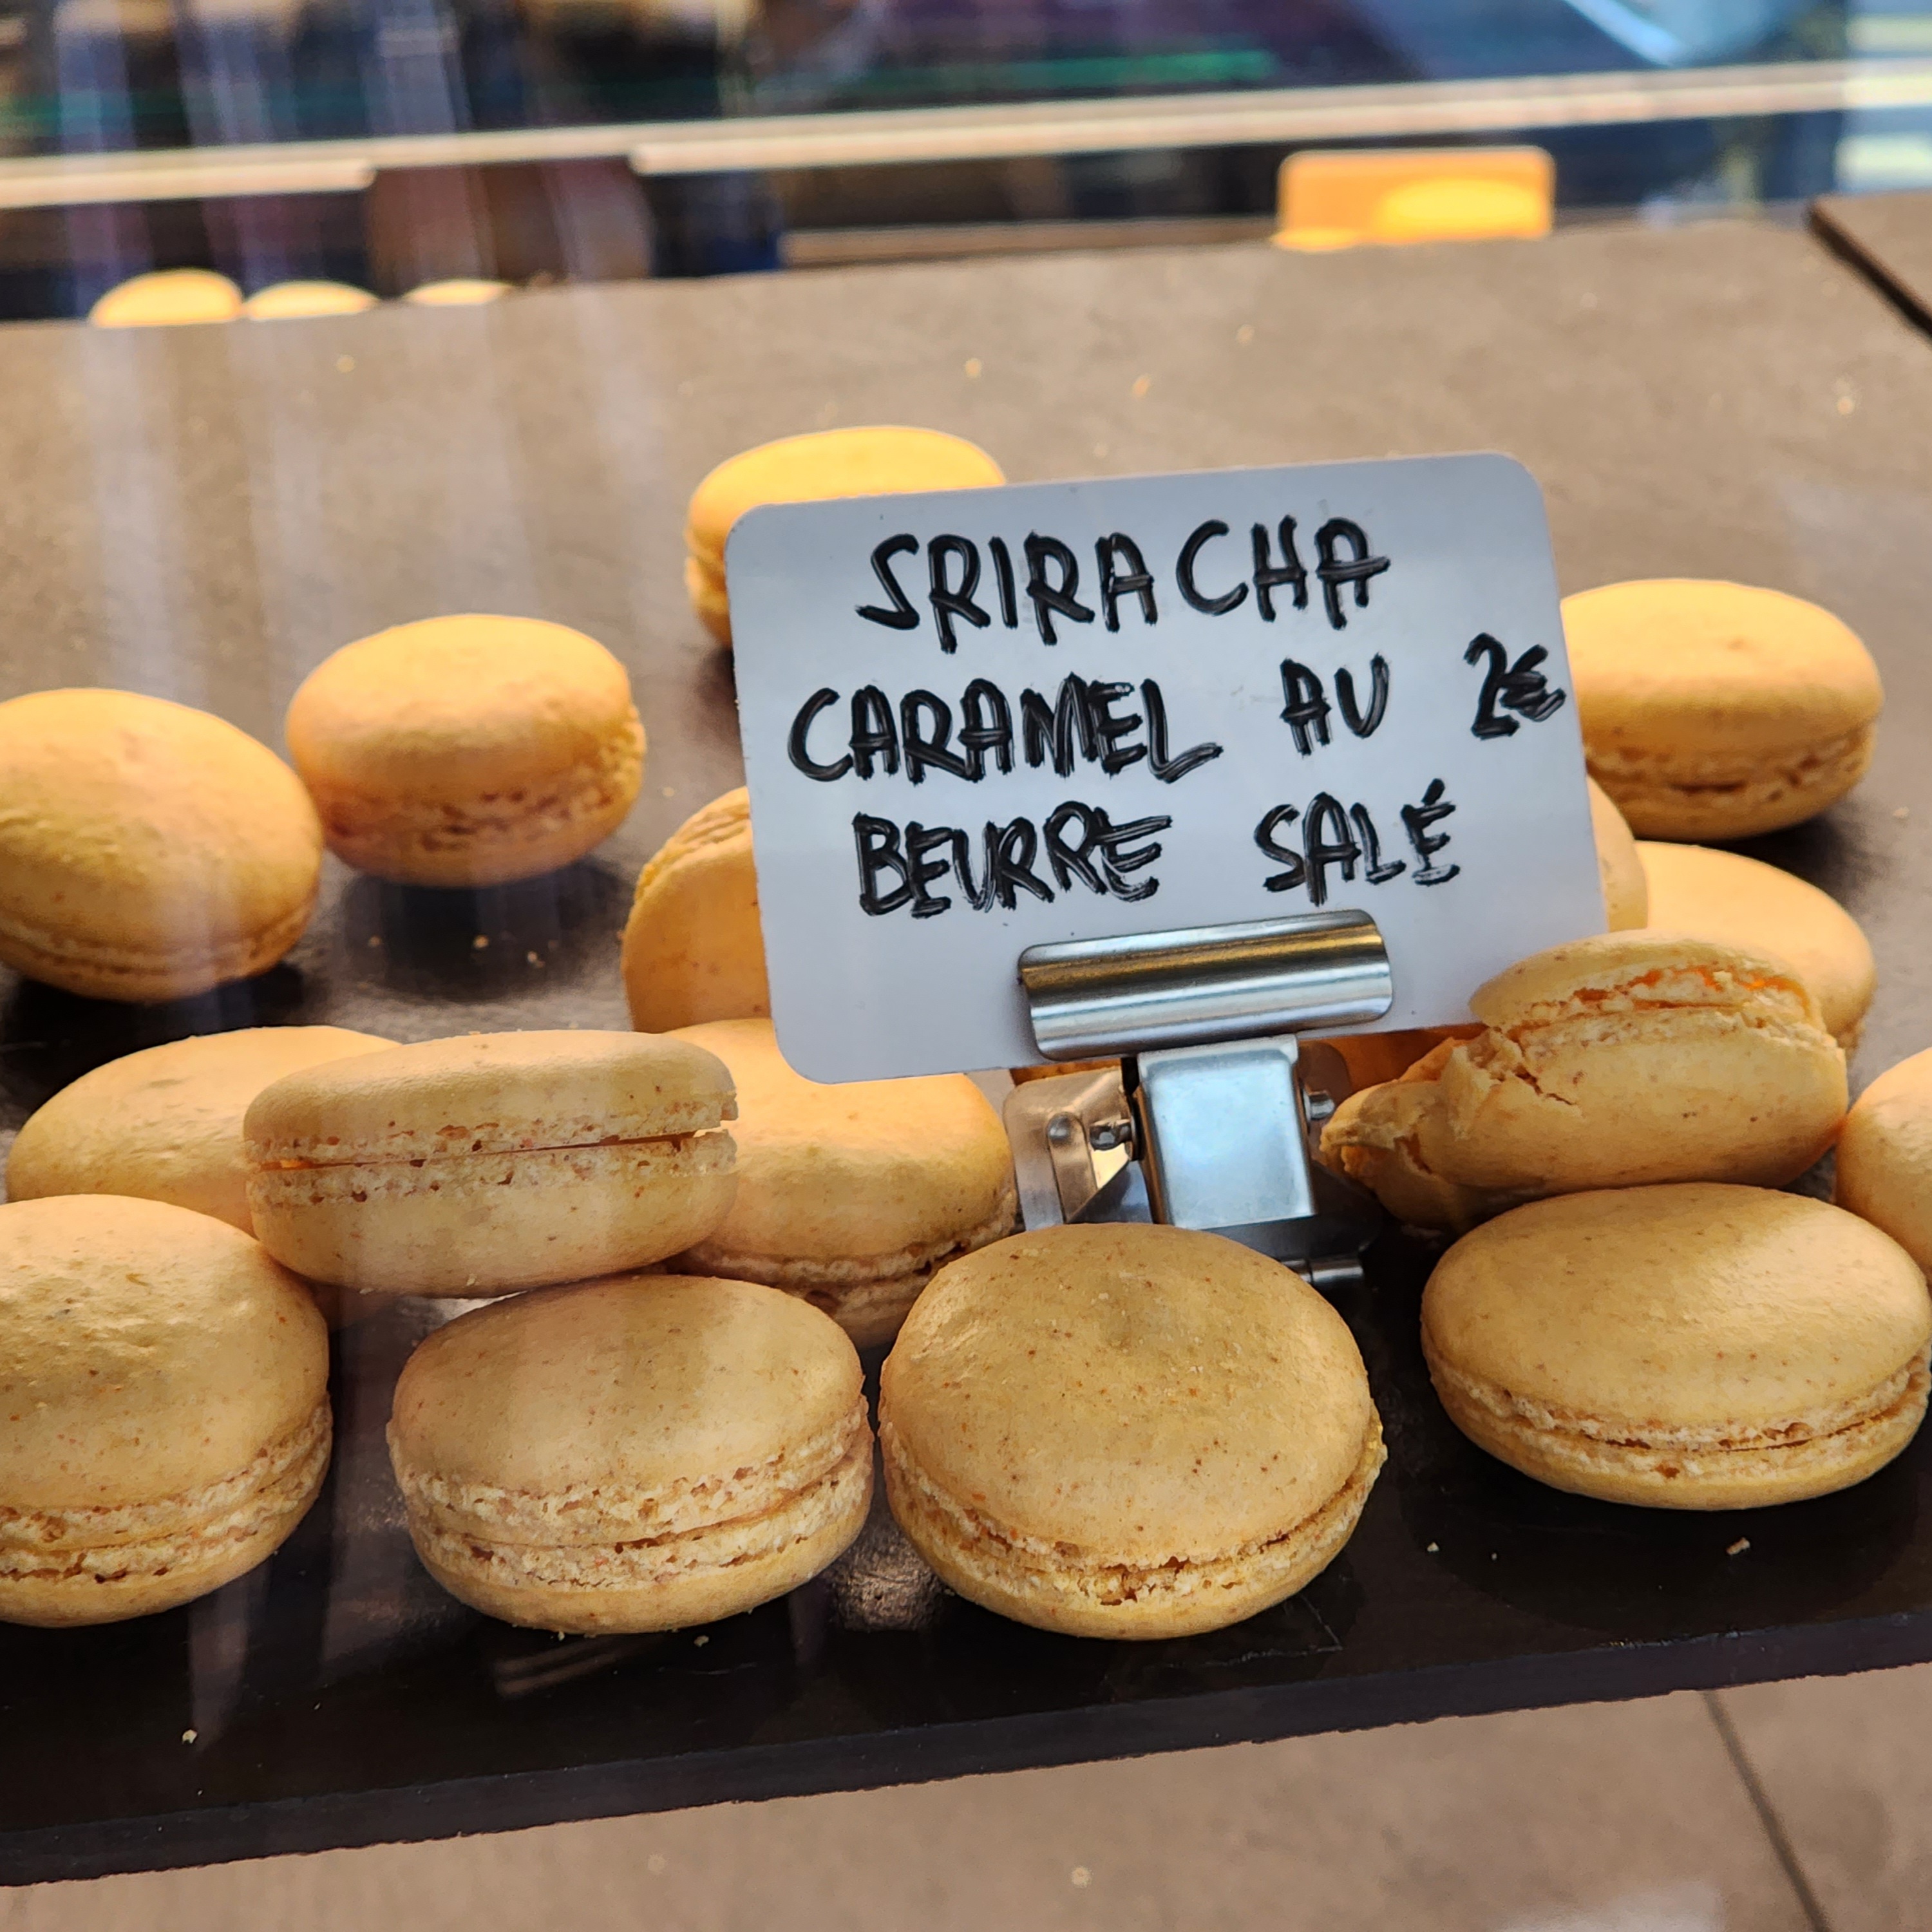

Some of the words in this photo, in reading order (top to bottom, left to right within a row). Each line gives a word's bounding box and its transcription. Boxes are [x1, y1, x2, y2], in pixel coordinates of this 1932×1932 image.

[855, 514, 1392, 655] SRIRACHA
[787, 671, 1224, 786] CARAMEL
[1279, 653, 1390, 757] AU
[1463, 632, 1567, 741] 2€
[851, 800, 1173, 920] BEURRE
[1253, 777, 1461, 908] SALÉ
